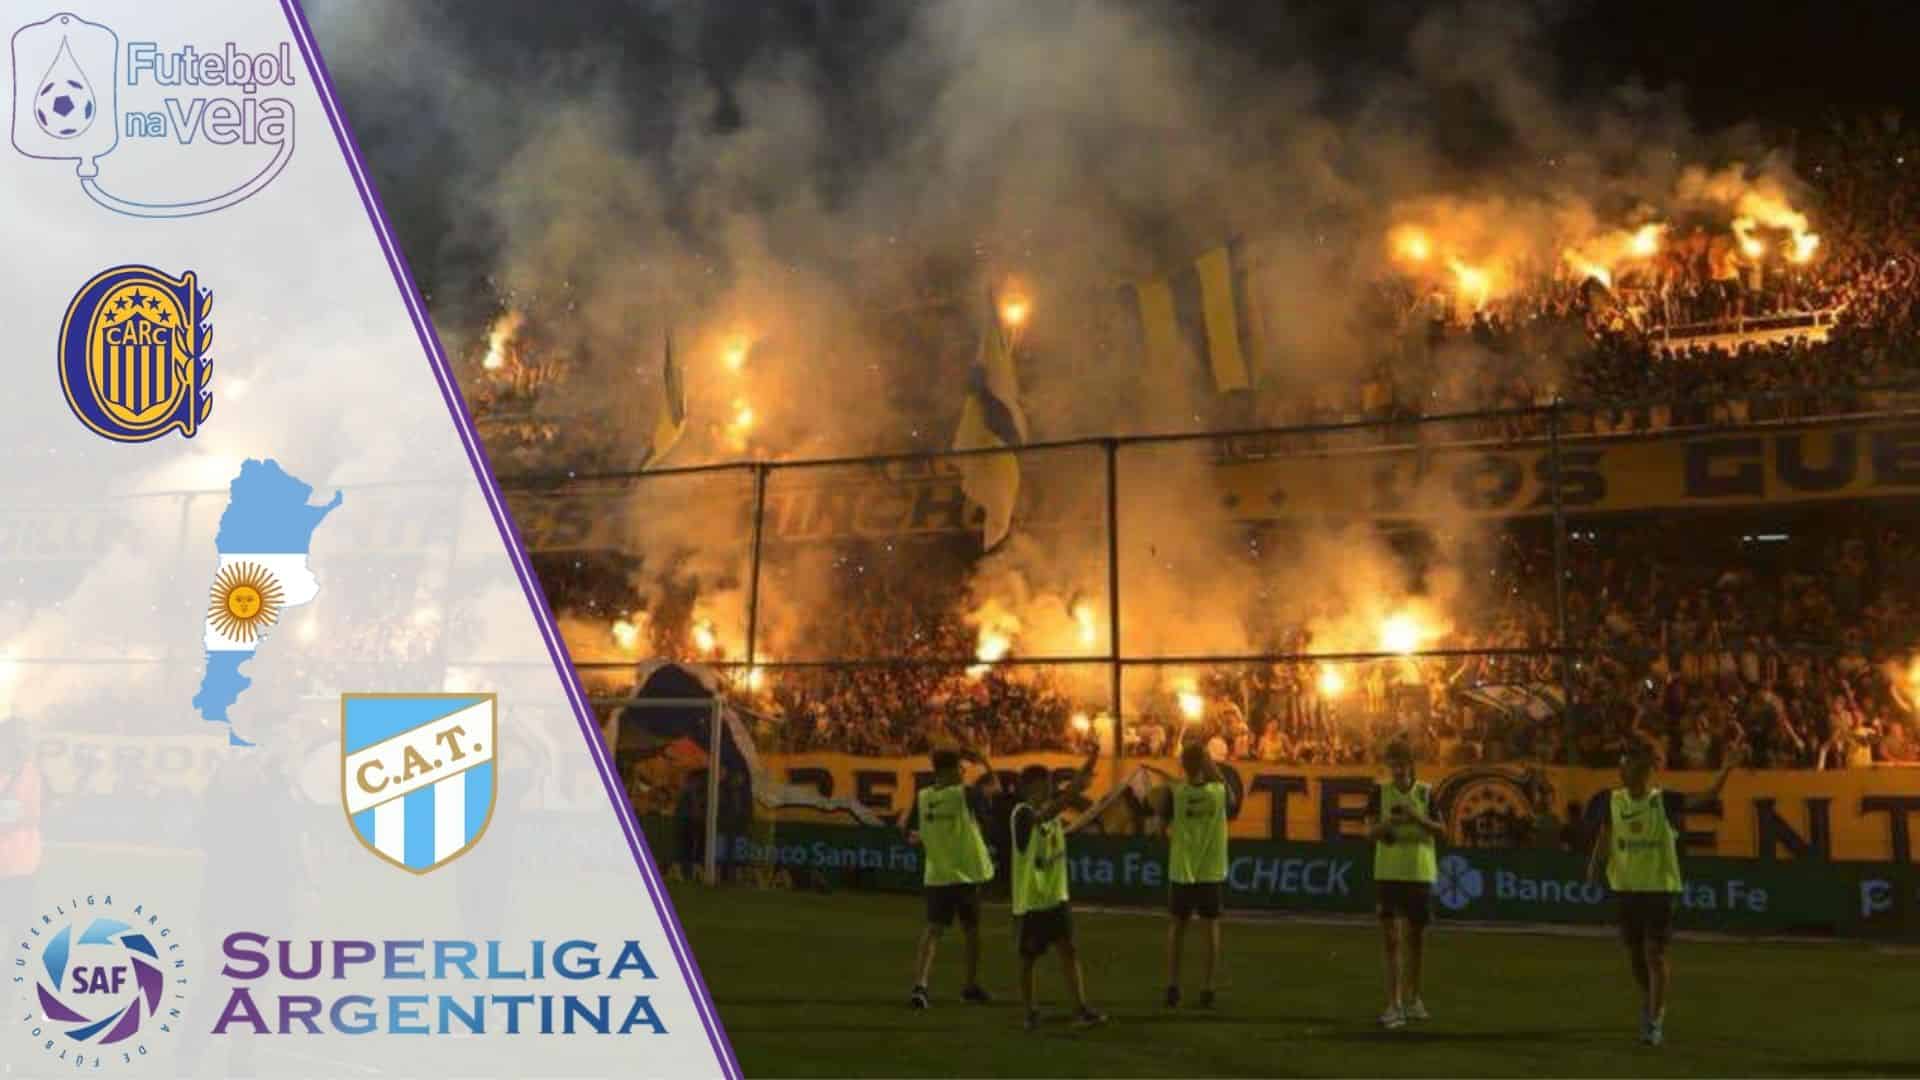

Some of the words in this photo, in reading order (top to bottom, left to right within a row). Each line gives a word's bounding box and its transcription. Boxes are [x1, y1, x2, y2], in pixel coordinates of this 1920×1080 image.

[733, 837, 807, 864] Banco
[811, 841, 882, 867] Santa
[1123, 853, 1162, 886] Fe
[1229, 855, 1353, 895] CHECK
[1726, 880, 1769, 912] Fe
